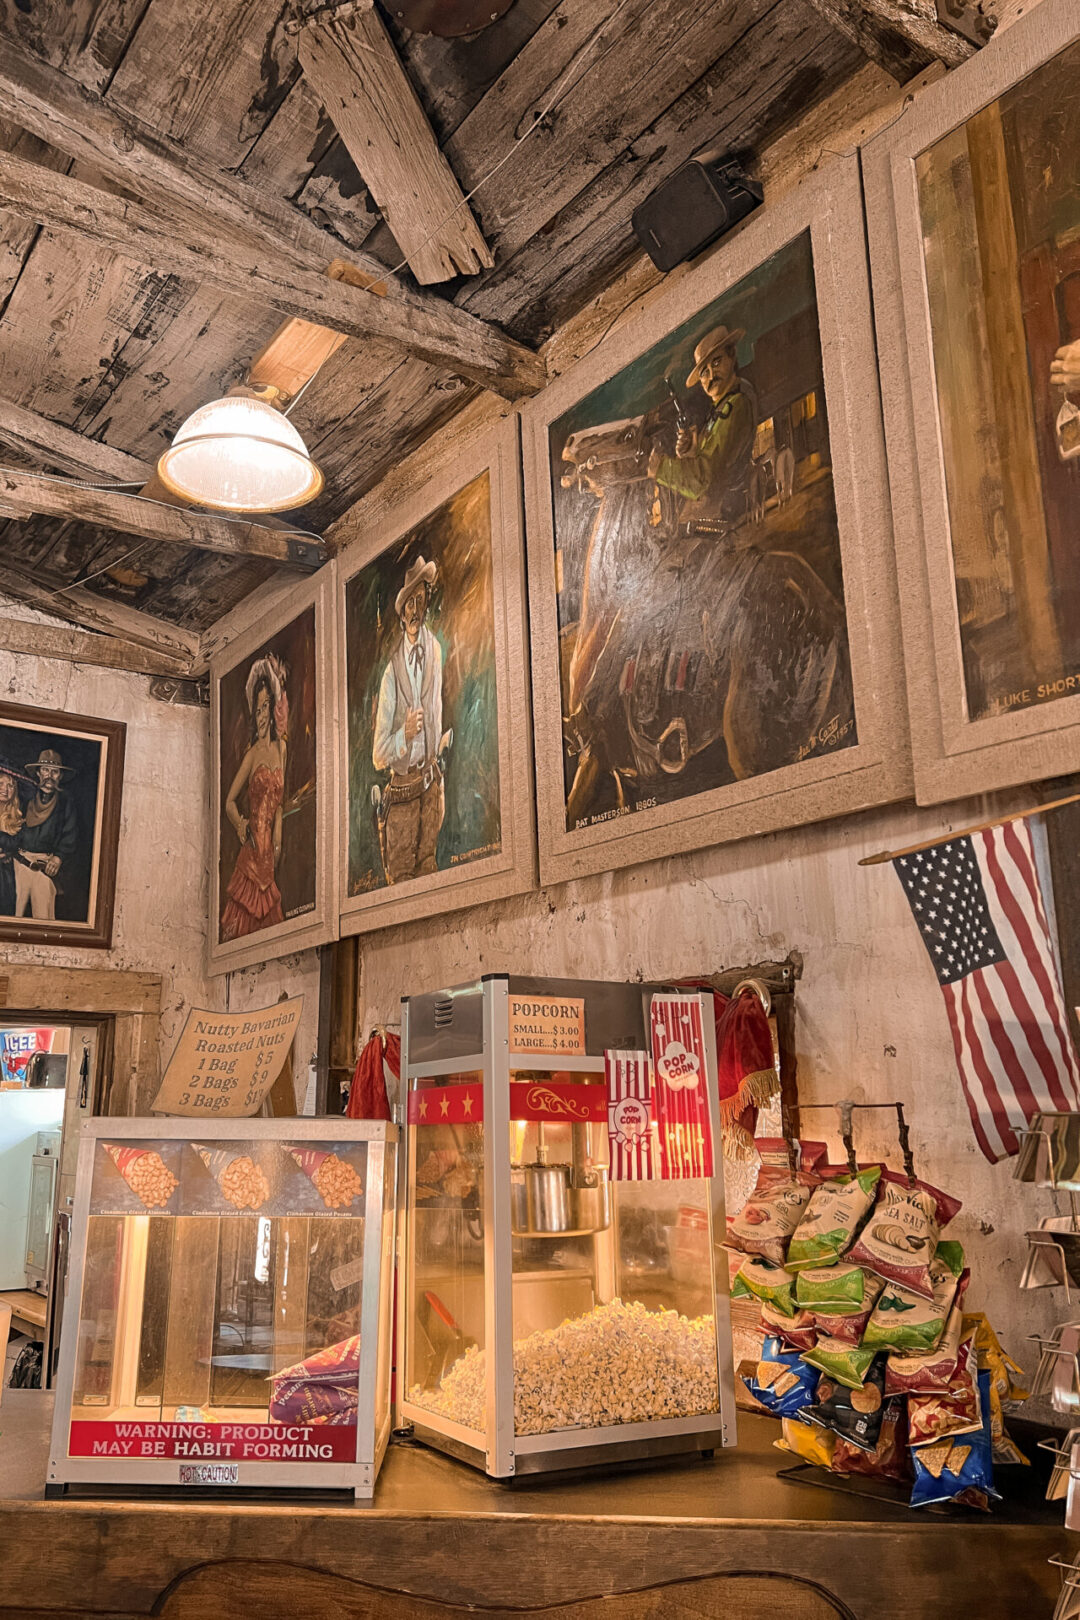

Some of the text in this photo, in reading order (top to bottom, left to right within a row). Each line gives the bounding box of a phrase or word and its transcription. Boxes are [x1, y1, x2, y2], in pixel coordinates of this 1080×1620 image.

[995, 689, 1031, 708] LUKE
[575, 817, 589, 829] BAT
[591, 805, 631, 824] MASTERSON
[512, 1002, 580, 1019] POPCORN
[193, 1012, 296, 1039] Nutty Bavarian
[194, 1032, 286, 1053] Roasted Nuts
[197, 1058, 206, 1070] 1
[208, 1058, 239, 1074] Bag
[663, 1053, 686, 1070] POP
[668, 1062, 695, 1079] CORN
[189, 1075, 201, 1088] 2
[202, 1075, 239, 1093] Bags
[178, 1092, 191, 1106] 3
[192, 1093, 231, 1111] Bags
[622, 1105, 640, 1114] POP
[619, 1116, 641, 1124] CORN
[883, 1207, 926, 1230] SEA SALT
[115, 1424, 313, 1441] WARNING: PRODUCT
[92, 1441, 333, 1459] MAY BE HABIT FORMING
